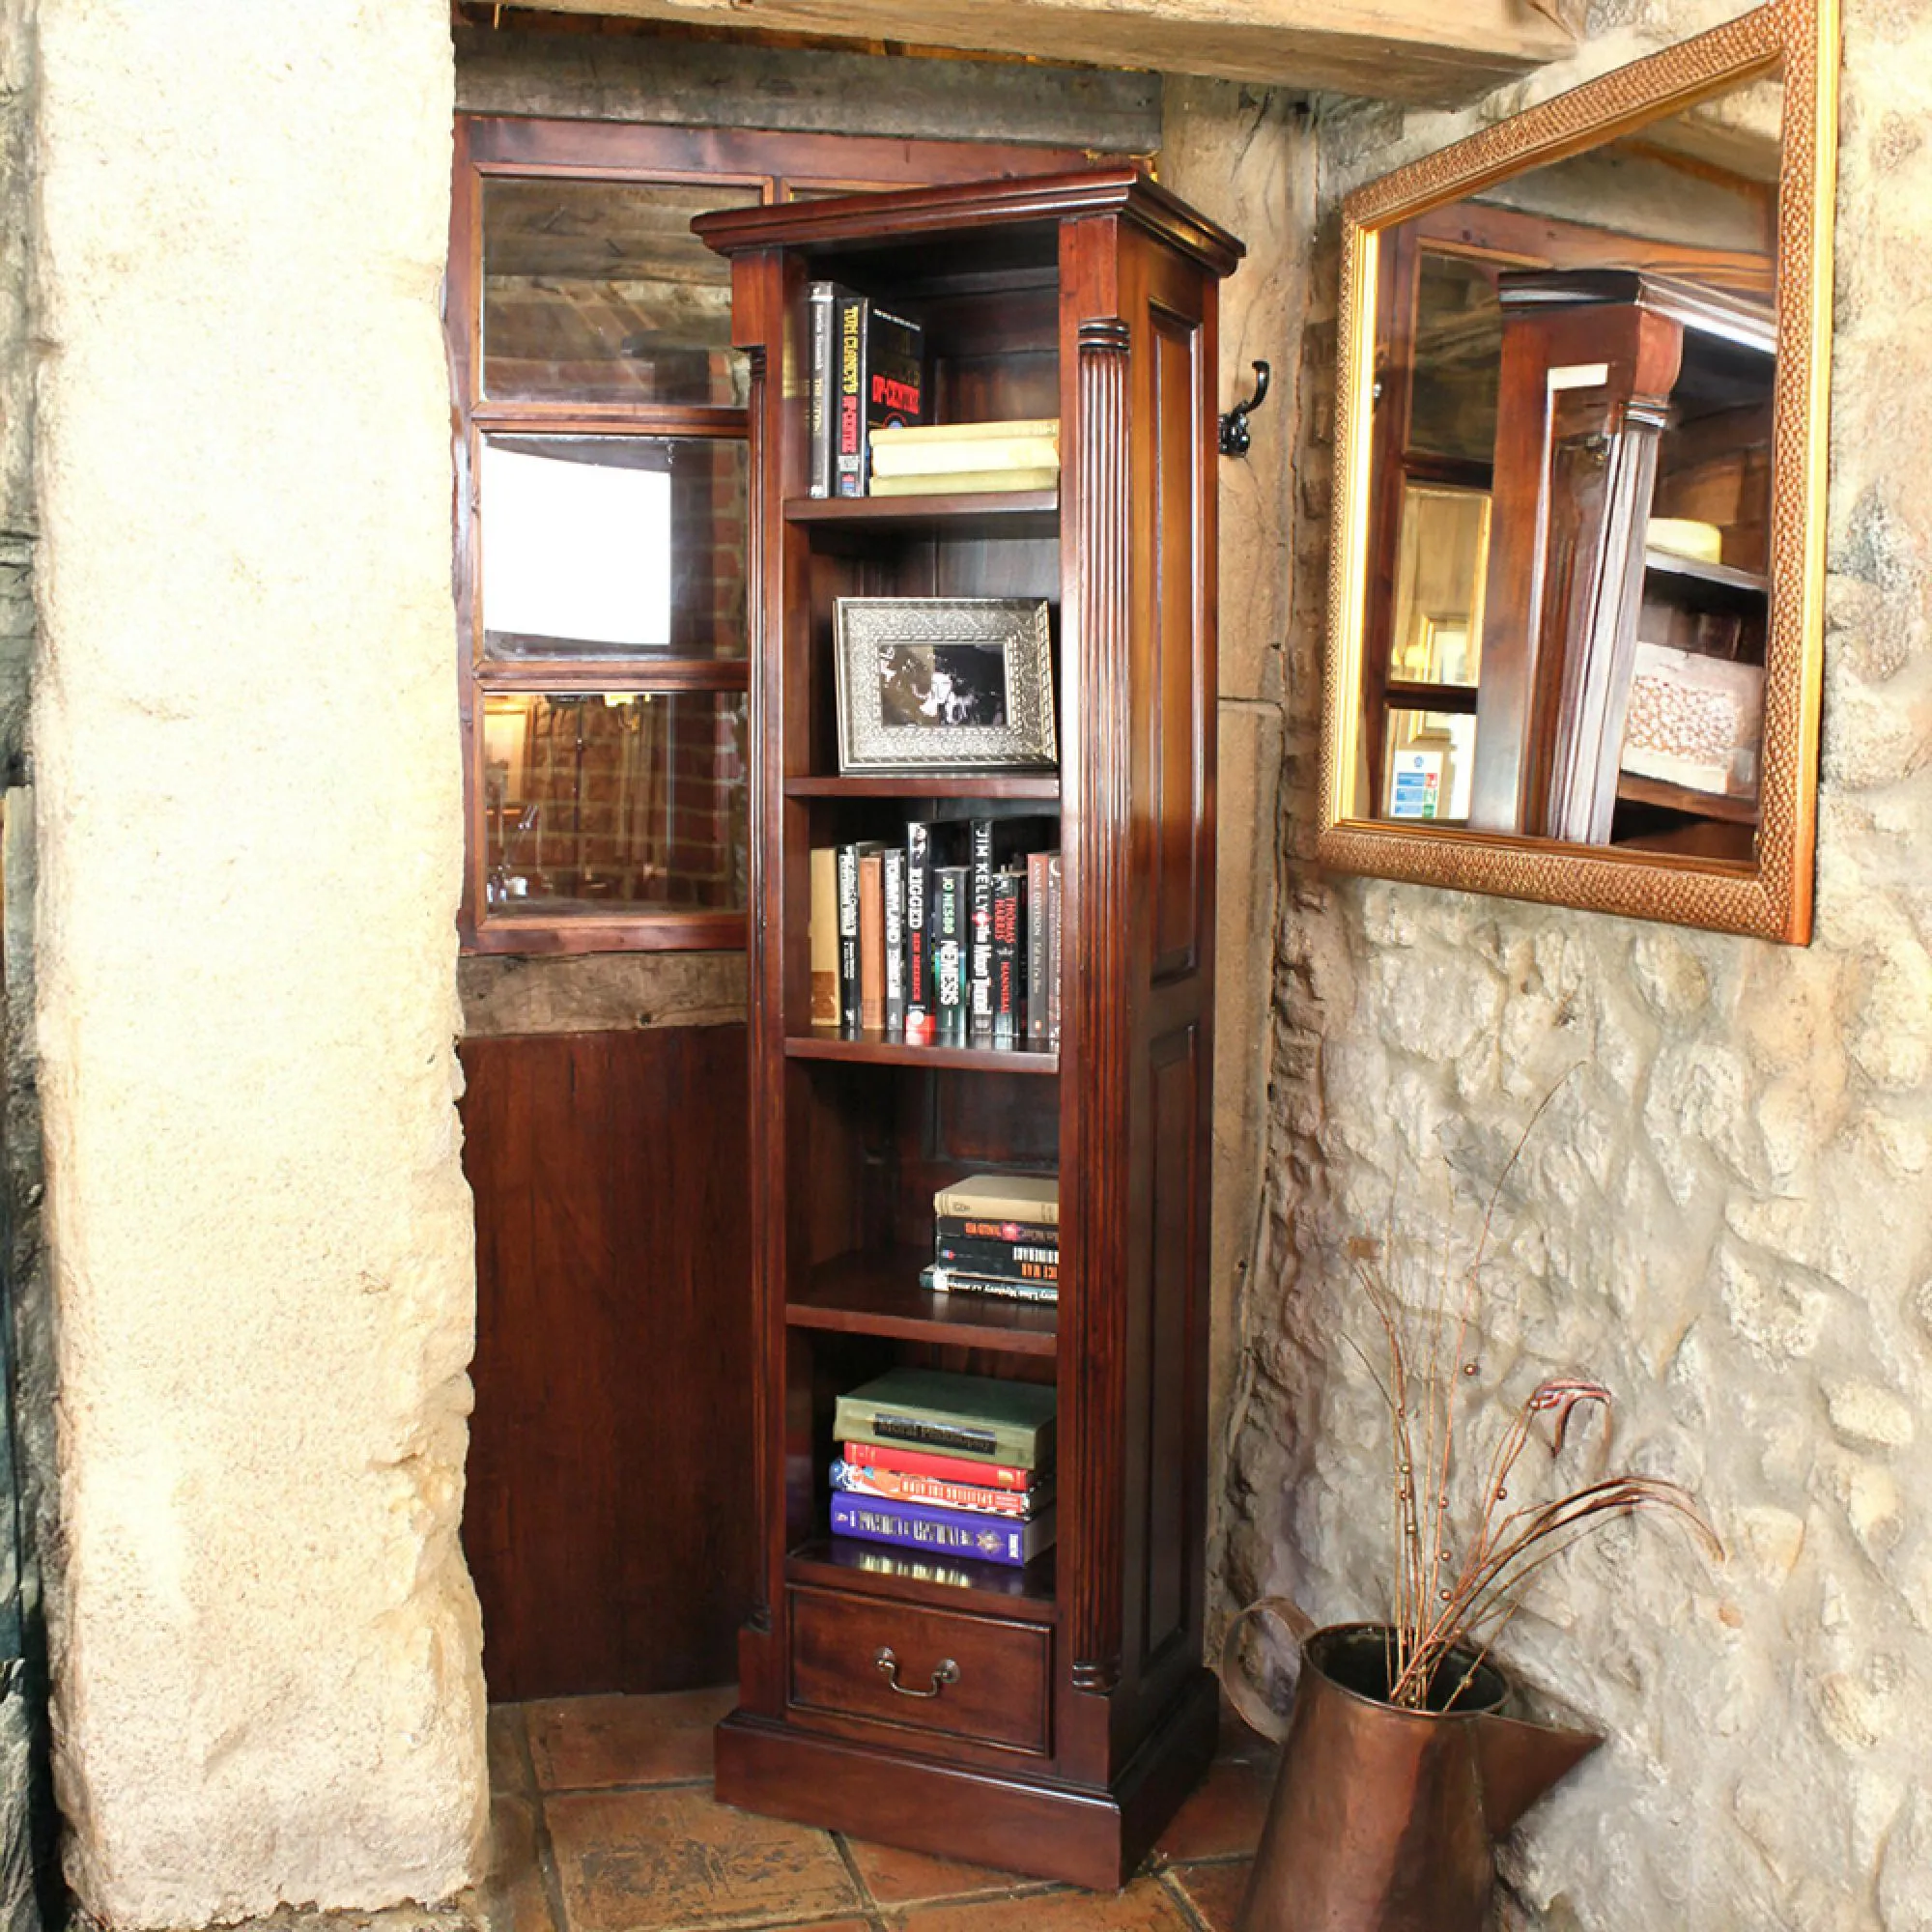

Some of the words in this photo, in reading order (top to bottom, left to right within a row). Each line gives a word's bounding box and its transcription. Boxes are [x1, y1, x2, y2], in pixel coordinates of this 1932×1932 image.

[843, 305, 859, 335] TOM
[975, 828, 988, 857] JIM
[909, 867, 923, 928] RIGGED
[975, 863, 988, 913] KELLY
[994, 898, 1007, 941] HARRIS
[1006, 896, 1017, 944] THOMAS
[940, 940, 959, 1006] NEMESIS
[1000, 961, 1011, 1014] HANNIBAL
